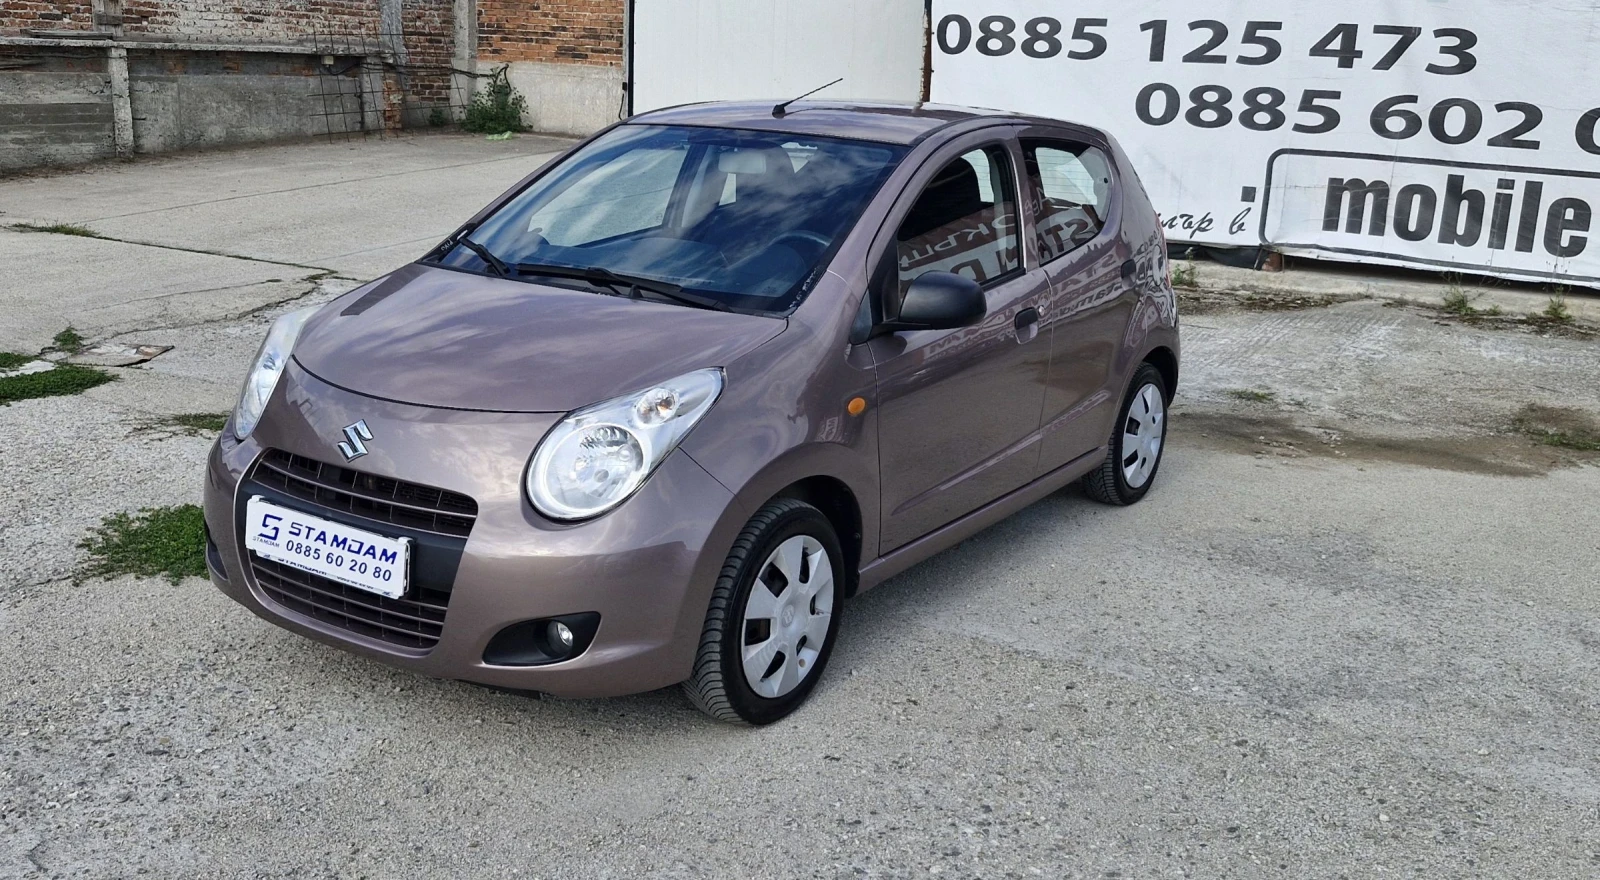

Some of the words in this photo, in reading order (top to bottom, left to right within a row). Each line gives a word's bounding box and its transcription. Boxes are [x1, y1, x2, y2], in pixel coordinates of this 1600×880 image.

[936, 13, 1108, 61] 0885
[1139, 19, 1283, 66] 125
[1308, 23, 1478, 76] 473
[1135, 82, 1342, 134] 0885
[1369, 94, 1543, 151] 602
[1322, 173, 1592, 258] mobile
[286, 540, 321, 561] 0885
[326, 552, 344, 567] 60
[349, 558, 368, 575] 20
[372, 566, 392, 582] 80
